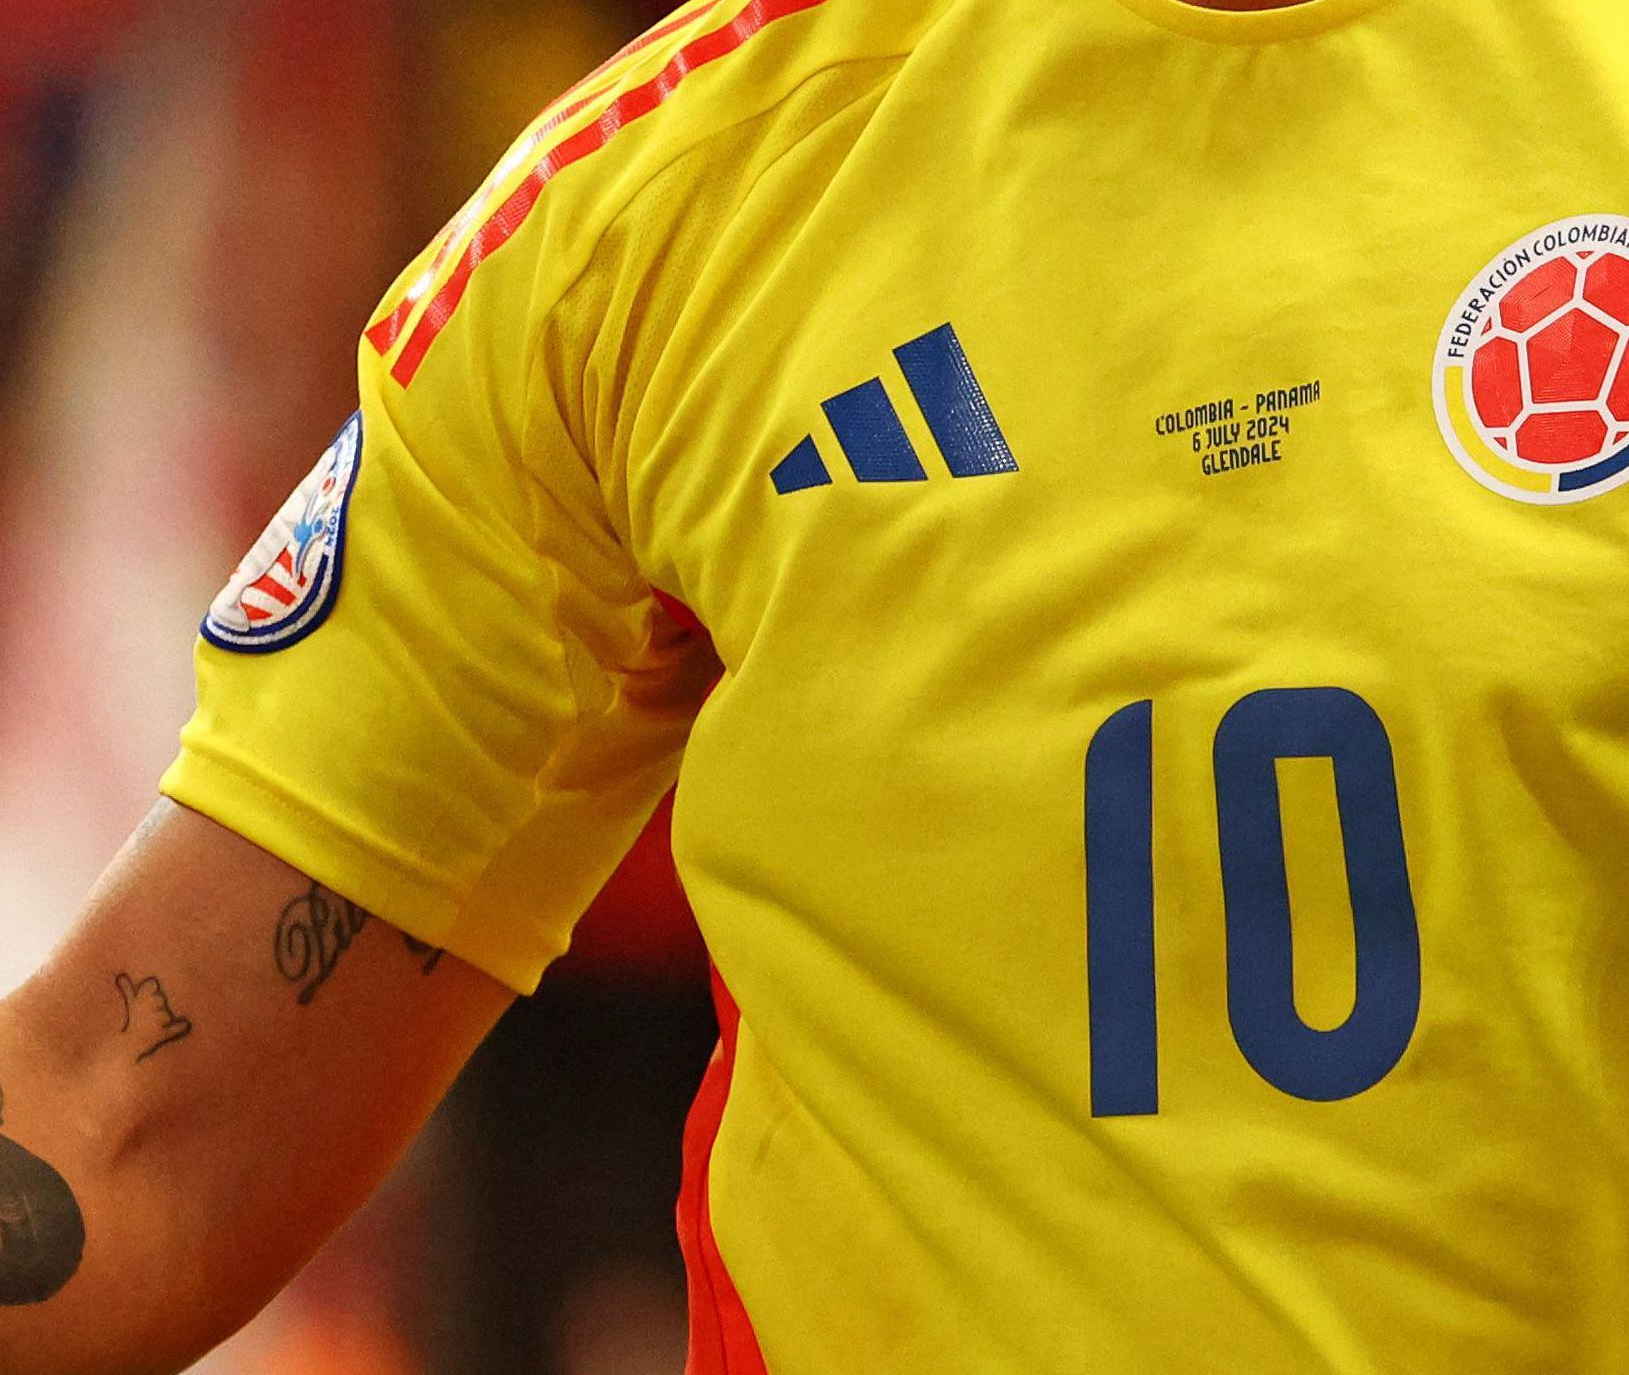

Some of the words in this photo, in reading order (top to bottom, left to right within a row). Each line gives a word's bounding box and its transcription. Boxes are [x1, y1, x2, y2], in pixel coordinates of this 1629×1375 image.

[1448, 248, 1531, 358] FEDERACIÓN
[1155, 398, 1234, 436] COLOMBIA
[1255, 379, 1320, 414] PANAMA
[1192, 431, 1201, 452] 6
[1207, 423, 1240, 449] JULY
[1246, 415, 1290, 441] 2024
[1201, 439, 1282, 476] GLENDALE
[1084, 685, 1421, 1117] 10
